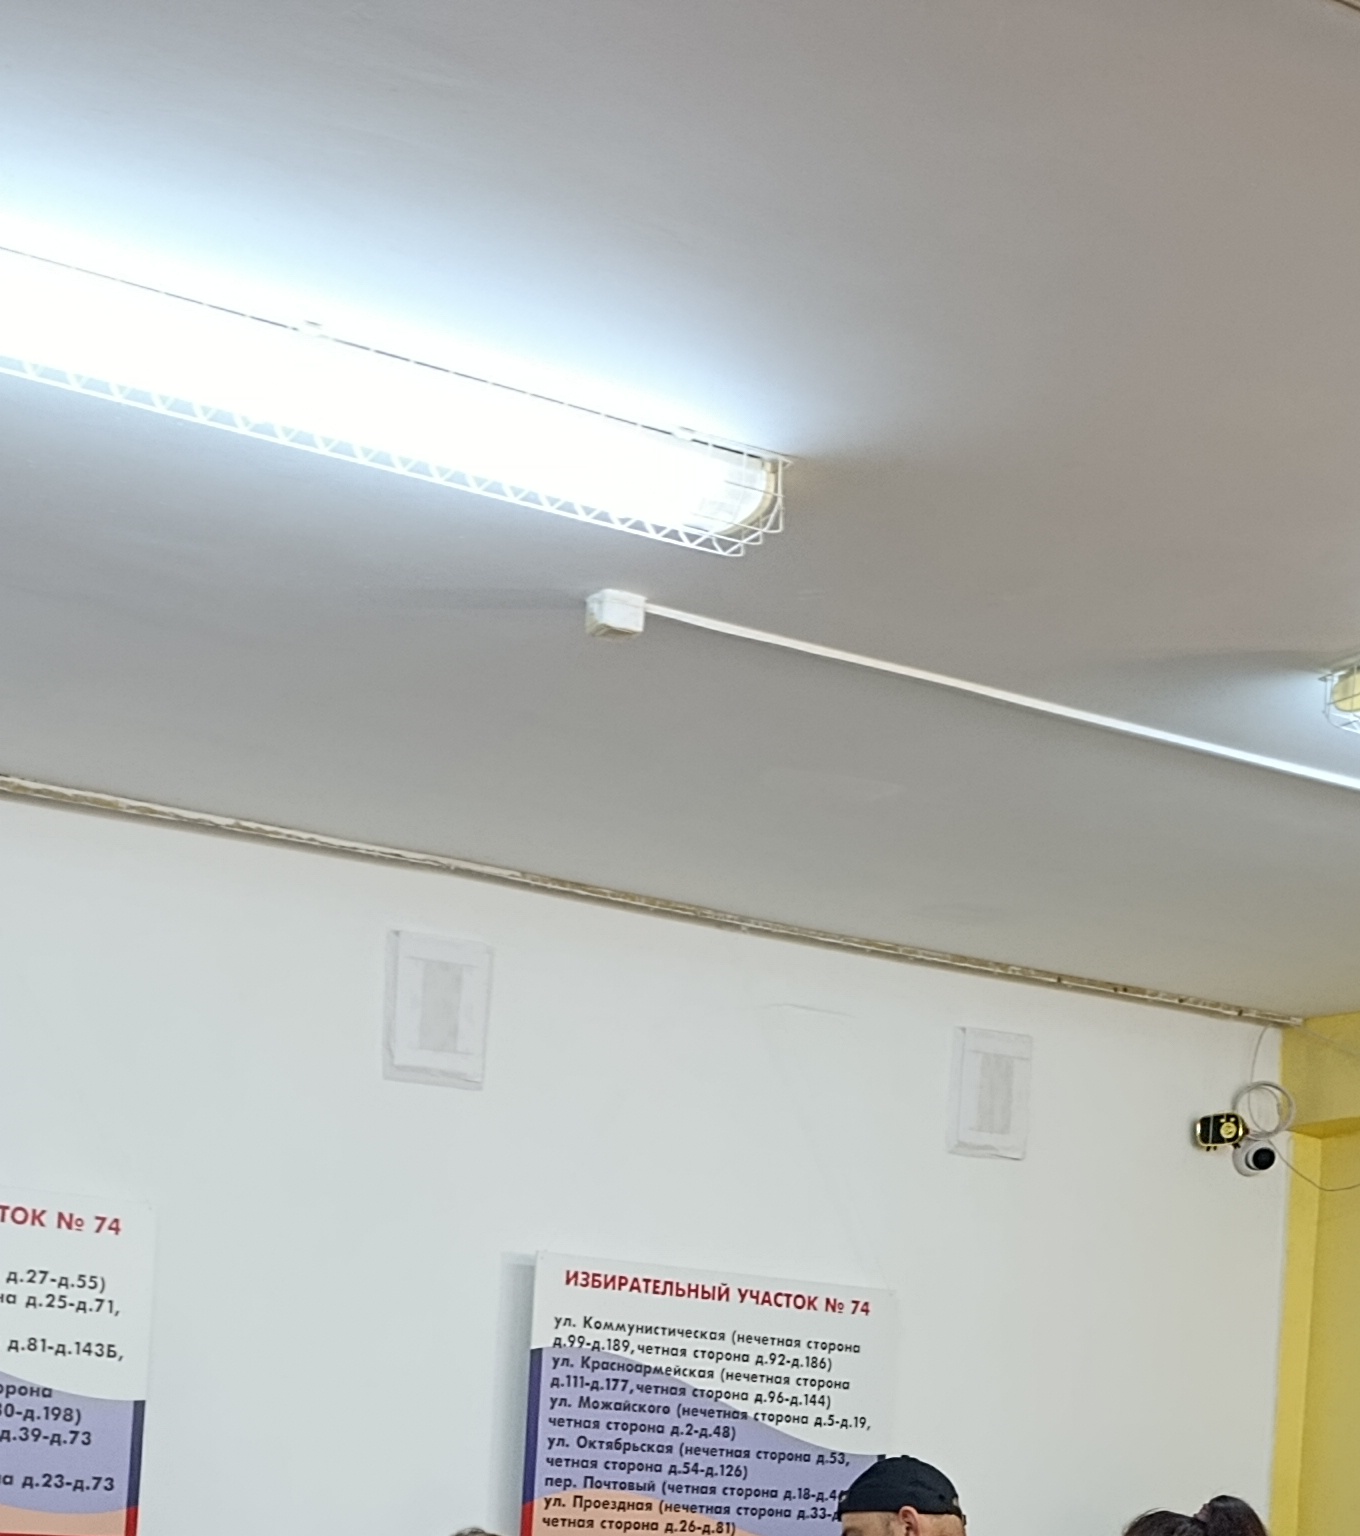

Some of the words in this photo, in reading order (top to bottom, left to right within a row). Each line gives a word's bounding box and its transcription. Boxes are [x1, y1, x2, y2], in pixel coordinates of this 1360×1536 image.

[57, 1212, 84, 1232] №
[94, 1216, 121, 1236] 74
[6, 1269, 106, 1294] д.27-д.55)
[565, 1270, 730, 1302] ИЗБИРАТЕЛЬНЫЙ
[738, 1288, 818, 1311] УЧАСТОК
[825, 1298, 844, 1314] №
[851, 1300, 870, 1316] 74
[25, 1294, 120, 1316] д.25-д.71,
[554, 1316, 576, 1330] ул.
[583, 1316, 725, 1341] Коммунистическая
[732, 1330, 801, 1348] (нечетная
[806, 1340, 860, 1354] сторона
[7, 1337, 124, 1362] д.81-д.143Б,
[693, 1350, 750, 1363] сторона
[755, 1353, 832, 1372] д.92-д.186)
[552, 1357, 574, 1370] ул.
[581, 1356, 714, 1379] Красноармейская
[720, 1368, 790, 1385] (нечетная
[796, 1378, 850, 1391] сторона
[692, 1388, 748, 1402] сторона
[754, 1391, 830, 1410] д.96-д.144)
[550, 1397, 572, 1410] ул.
[578, 1396, 670, 1414] Можайского
[677, 1403, 748, 1420] (нечетная
[754, 1412, 808, 1425] сторона
[814, 1414, 871, 1431] д.5-д.19,
[548, 1418, 600, 1429] четная
[606, 1421, 664, 1435] сторона
[670, 1423, 736, 1441] д.2-д.48)
[548, 1437, 570, 1450] ул.
[576, 1436, 673, 1454] Октябрьская
[679, 1442, 750, 1458] (нечетная
[756, 1450, 811, 1464] сторона
[816, 1452, 850, 1467] д.53,
[546, 1457, 598, 1468] четная
[604, 1460, 662, 1474] сторона
[668, 1462, 748, 1480] д.54-д.126)
[22, 1473, 114, 1492] д.23-д.73
[544, 1478, 577, 1491] пер.
[583, 1476, 656, 1492] Почтовый
[662, 1480, 716, 1496] (четная
[722, 1487, 778, 1500] сторона
[783, 1488, 840, 1502] д.18-д.4
[544, 1498, 566, 1510] ул.
[572, 1495, 652, 1512] Проездная
[659, 1500, 730, 1515] (нечетная
[736, 1506, 792, 1520] сторона
[542, 1518, 594, 1528] четная
[600, 1520, 658, 1533] сторона
[664, 1520, 736, 1536] д.26-д.81)
